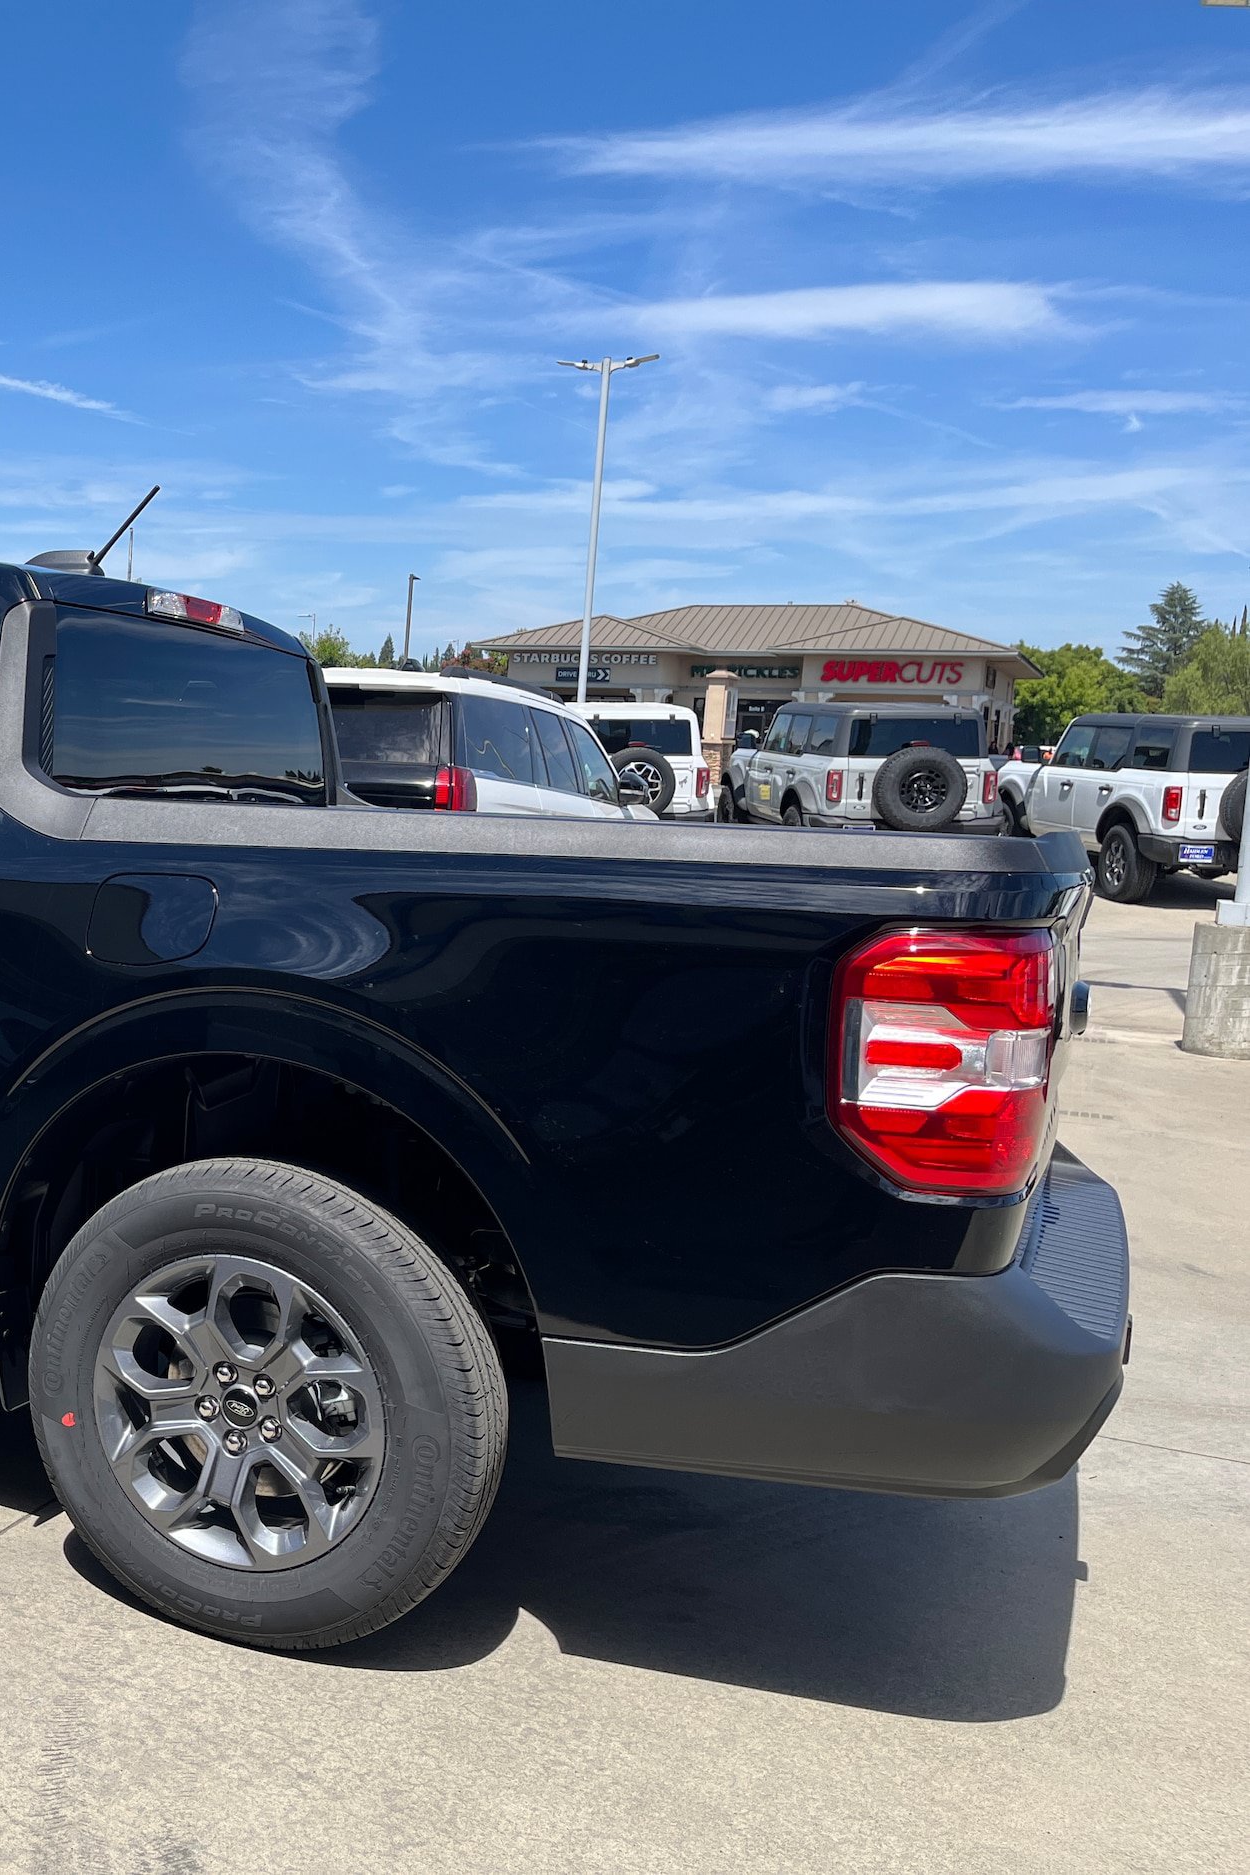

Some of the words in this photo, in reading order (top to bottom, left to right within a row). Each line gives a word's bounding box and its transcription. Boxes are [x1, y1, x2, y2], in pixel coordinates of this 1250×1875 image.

[513, 652, 599, 664] STARBUCS
[601, 653, 657, 665] COFFEE
[557, 670, 578, 678] DRIVE
[820, 660, 965, 685] SUPERCUTS
[42, 1260, 98, 1398] Continental
[372, 1434, 442, 1580] Continental
